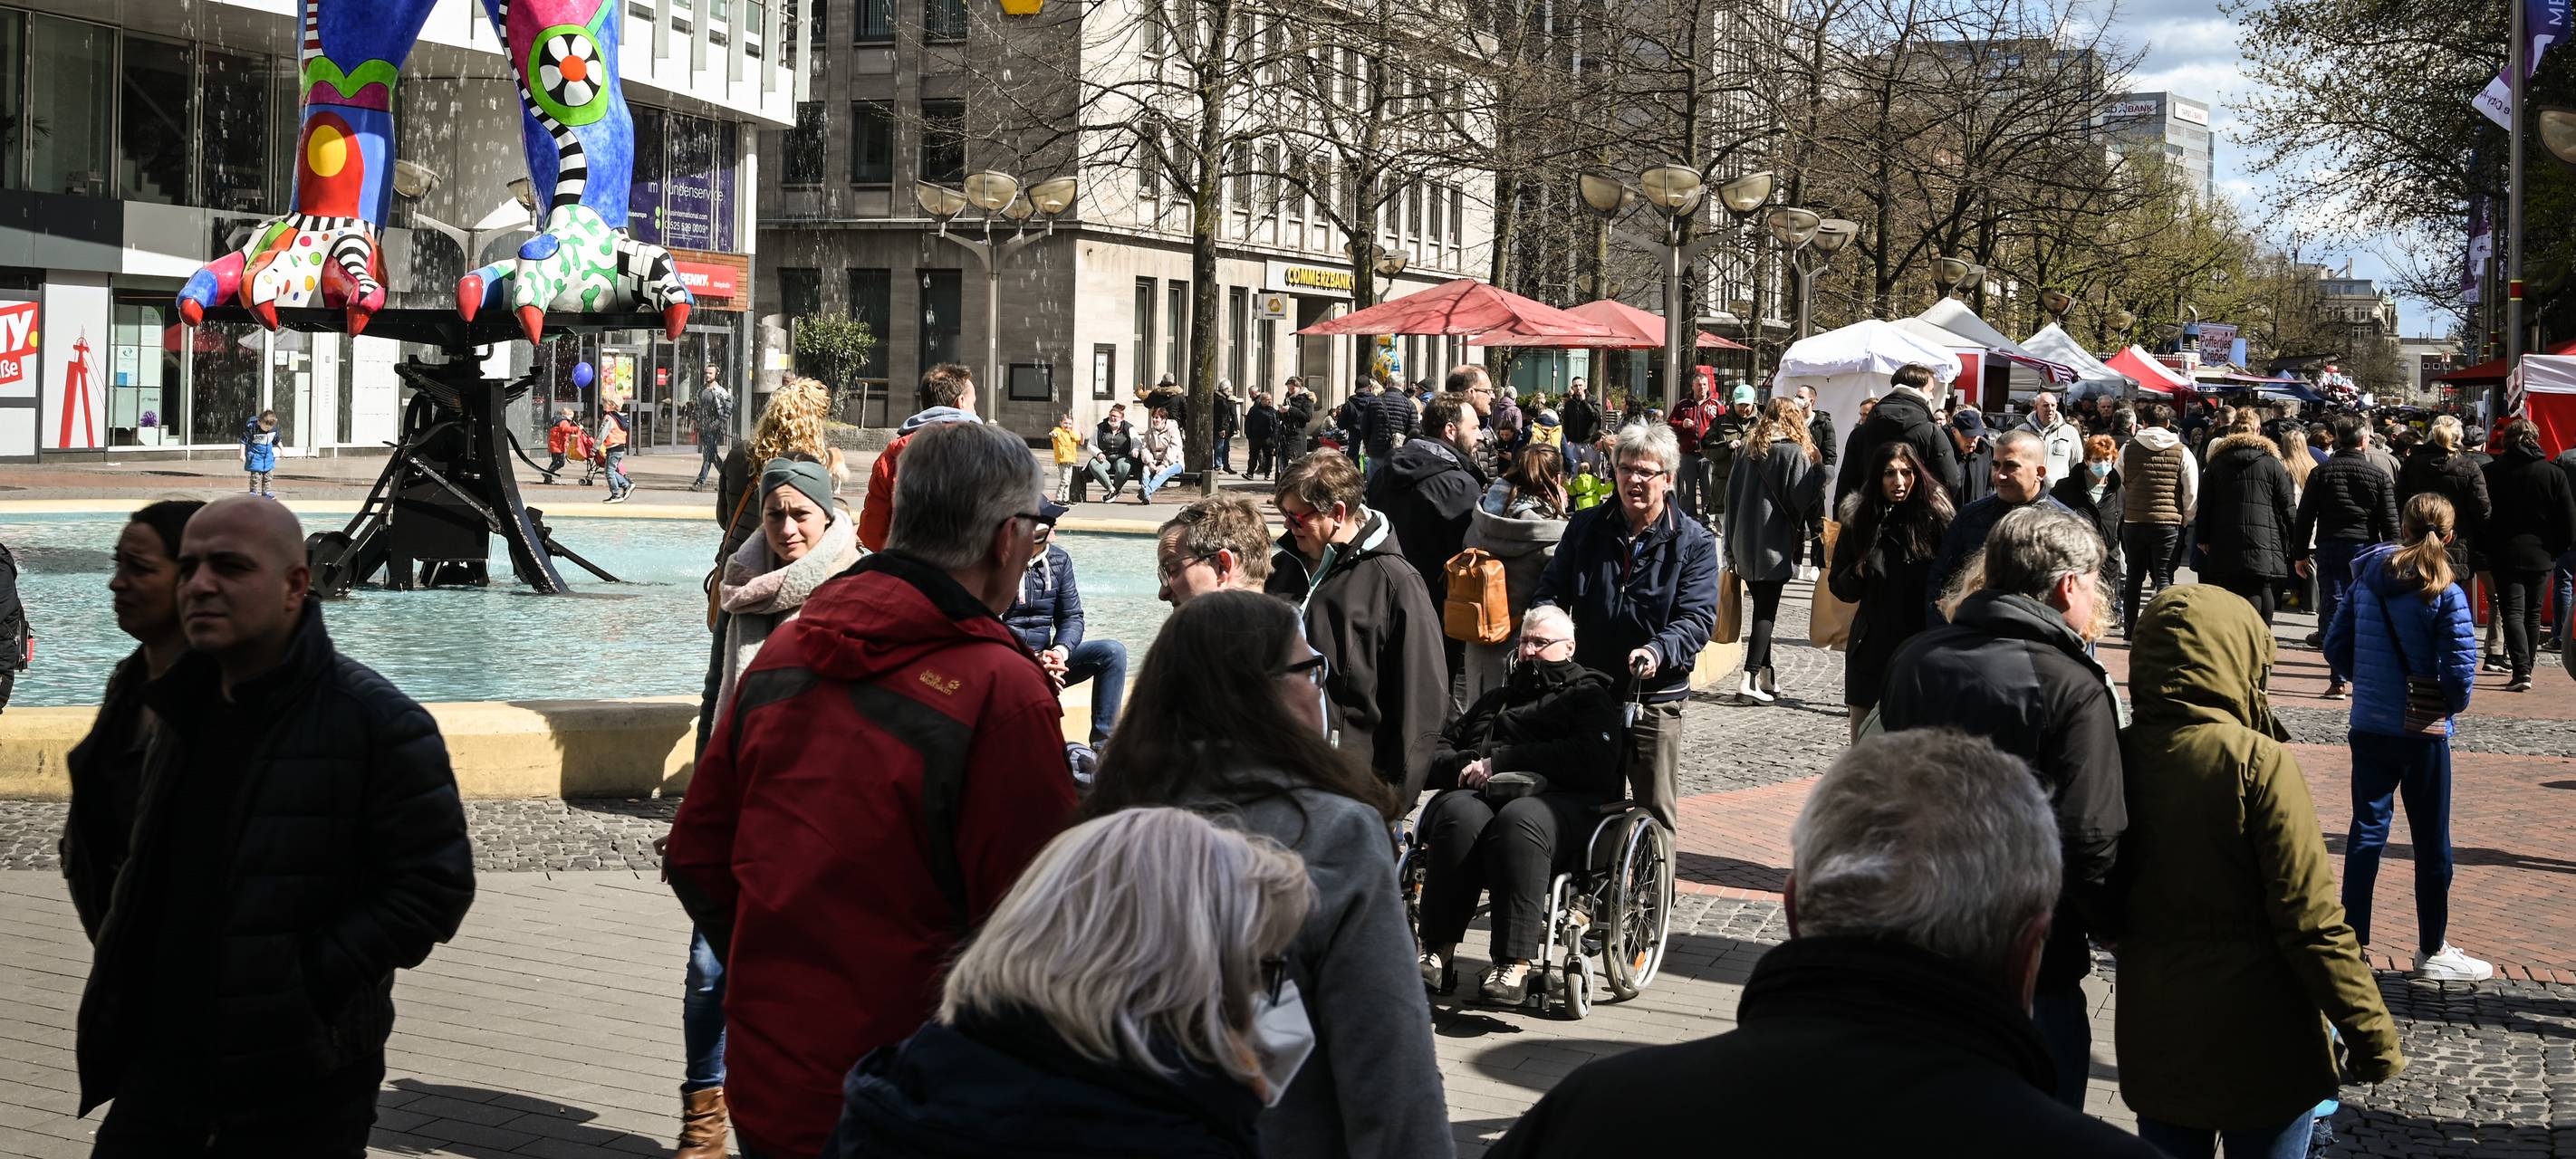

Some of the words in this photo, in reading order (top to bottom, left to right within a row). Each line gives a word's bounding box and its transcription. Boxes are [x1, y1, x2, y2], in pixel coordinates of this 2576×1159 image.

[2128, 104, 2153, 113] BANK
[648, 181, 658, 193] im
[664, 182, 724, 202] Kundenservce
[1287, 267, 1352, 290] COMMERZBANK
[2200, 335, 2232, 351] Poffertjes
